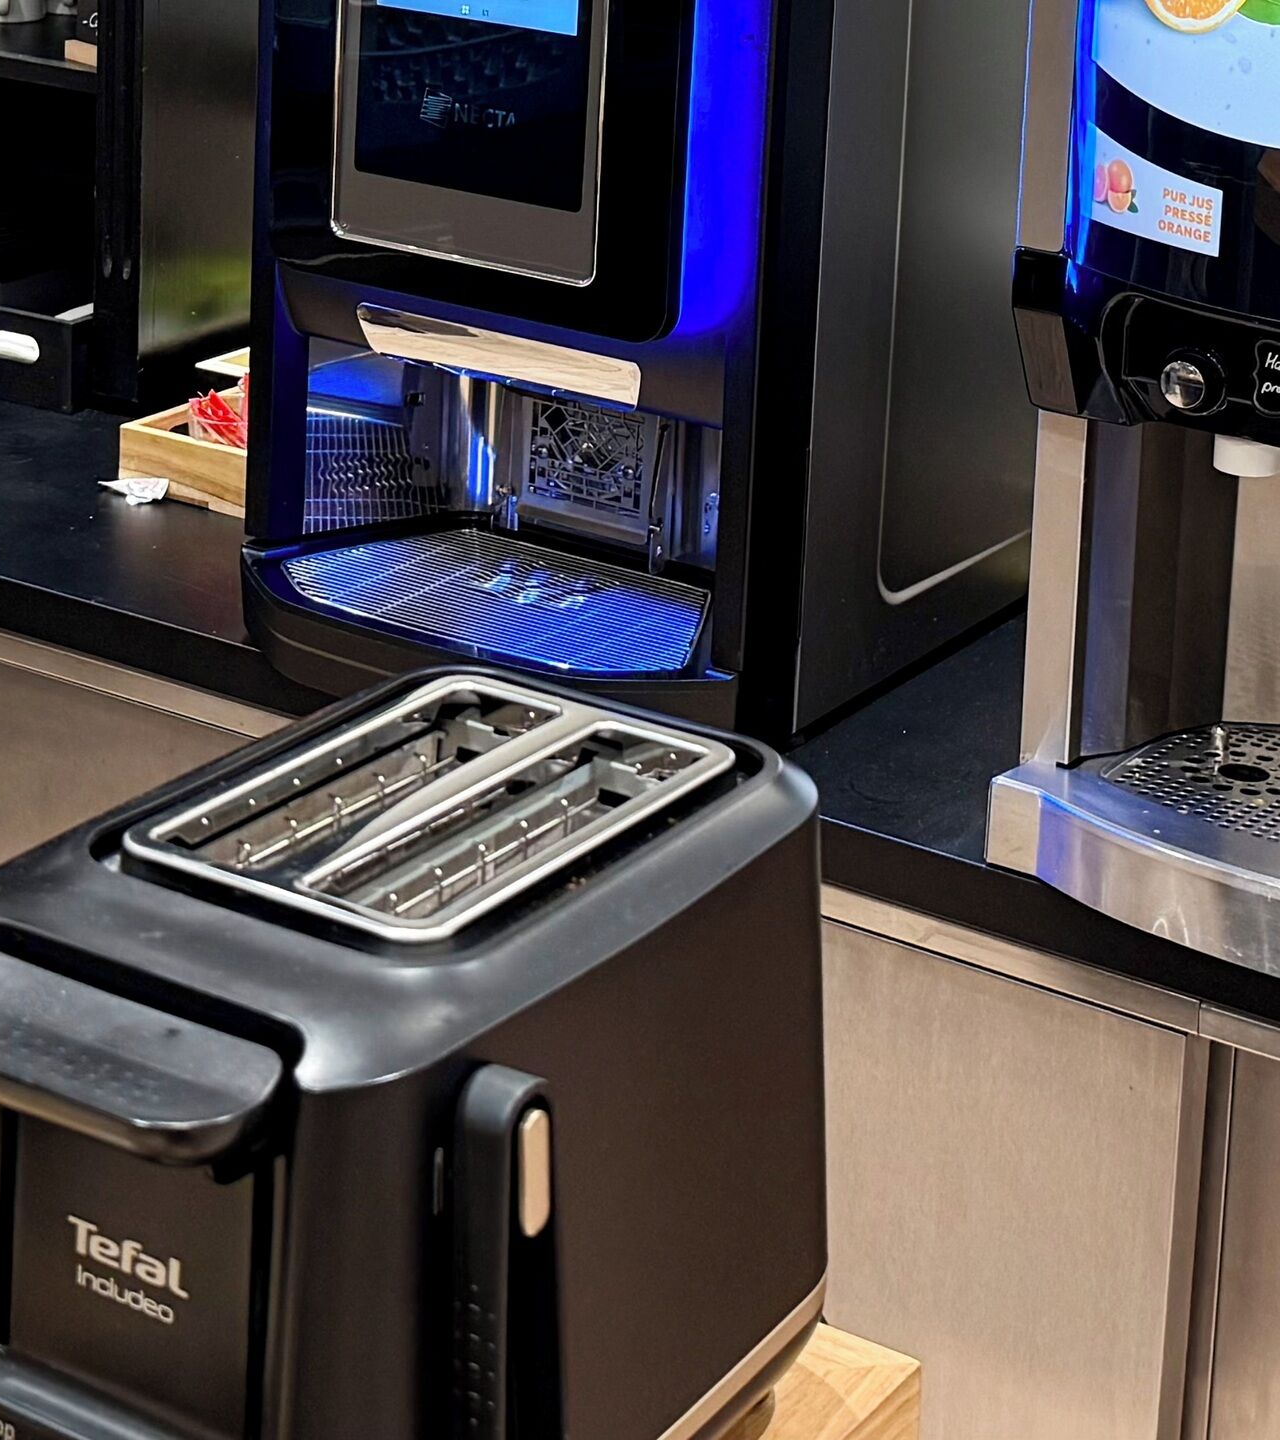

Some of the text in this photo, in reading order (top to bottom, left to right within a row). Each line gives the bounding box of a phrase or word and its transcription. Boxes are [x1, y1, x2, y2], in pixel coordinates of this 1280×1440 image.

[1163, 188, 1213, 211] PUR JUS
[1164, 204, 1213, 227] PRESSÉ
[1158, 219, 1211, 243] ORANGE
[67, 1214, 190, 1300] Tefal
[76, 1263, 175, 1325] Includeo
